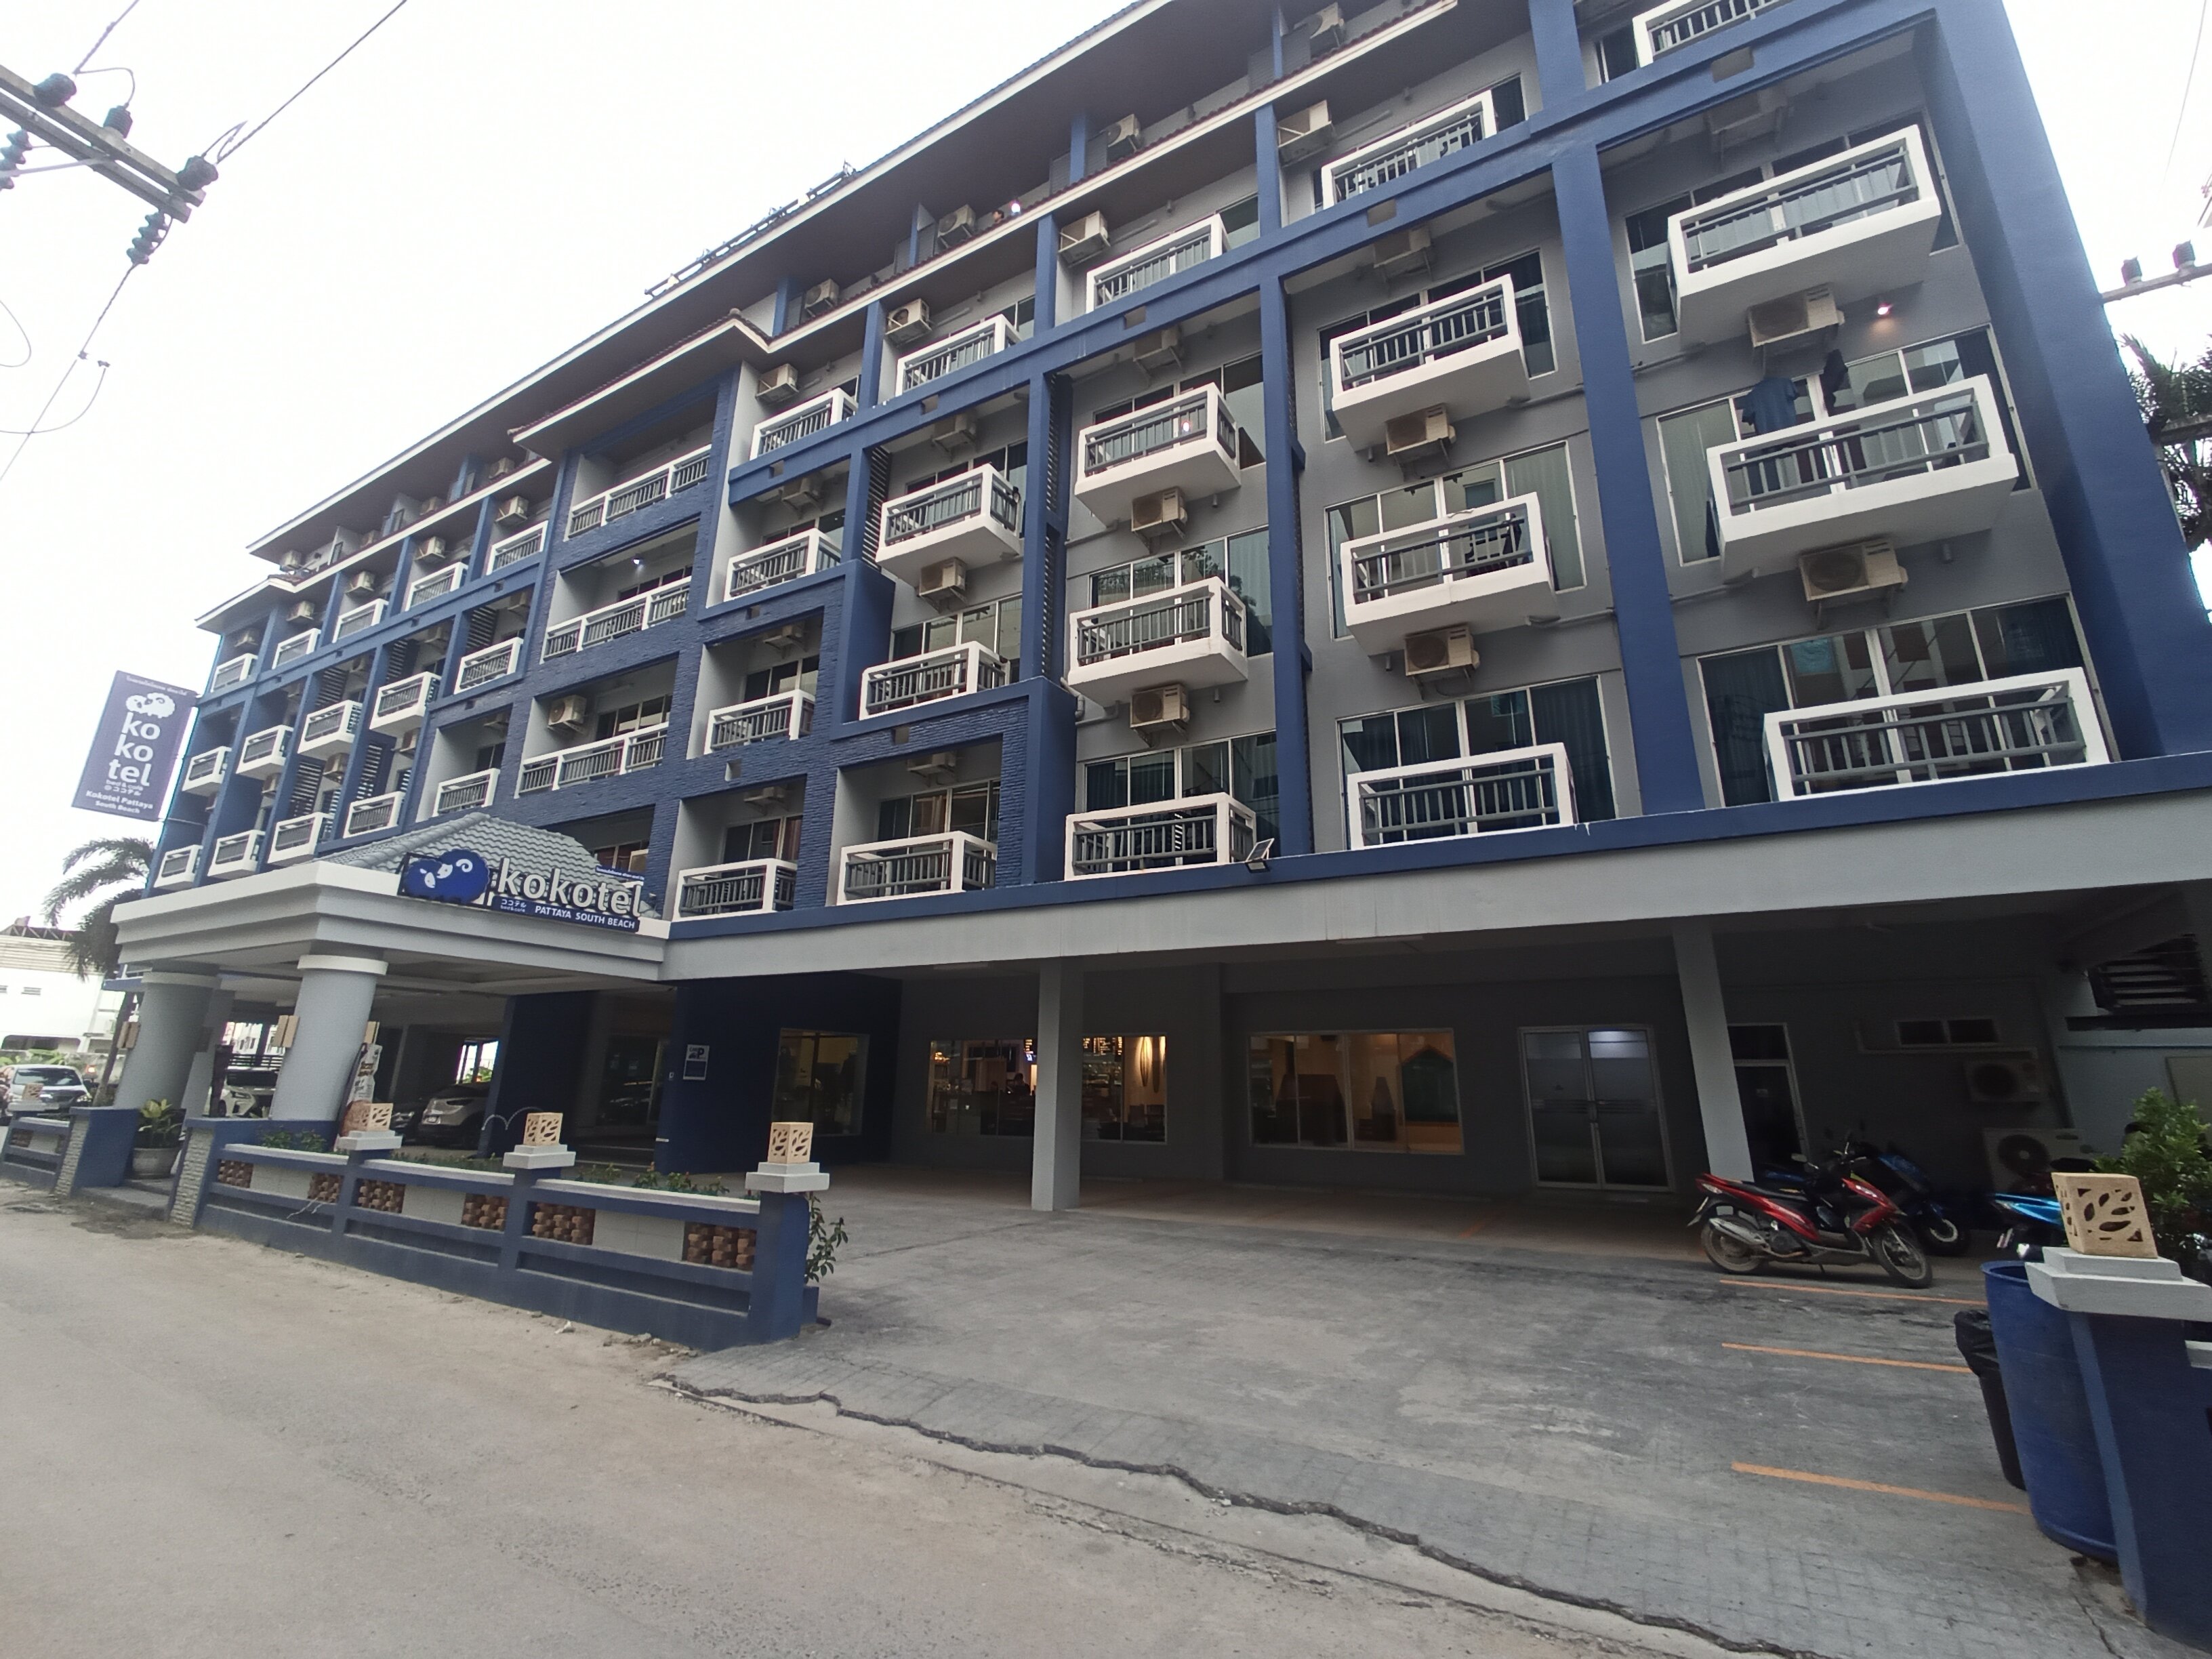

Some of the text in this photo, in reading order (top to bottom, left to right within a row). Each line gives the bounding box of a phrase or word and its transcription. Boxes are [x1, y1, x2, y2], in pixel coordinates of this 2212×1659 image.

[121, 712, 161, 740] ko
[114, 734, 153, 762] ko
[108, 758, 152, 786] tel
[85, 790, 153, 809] Kokotel Pattaya
[96, 800, 140, 813] South Beach
[497, 857, 642, 917] kokotel
[535, 905, 635, 928] PATTAYA SOUTH BEACH
